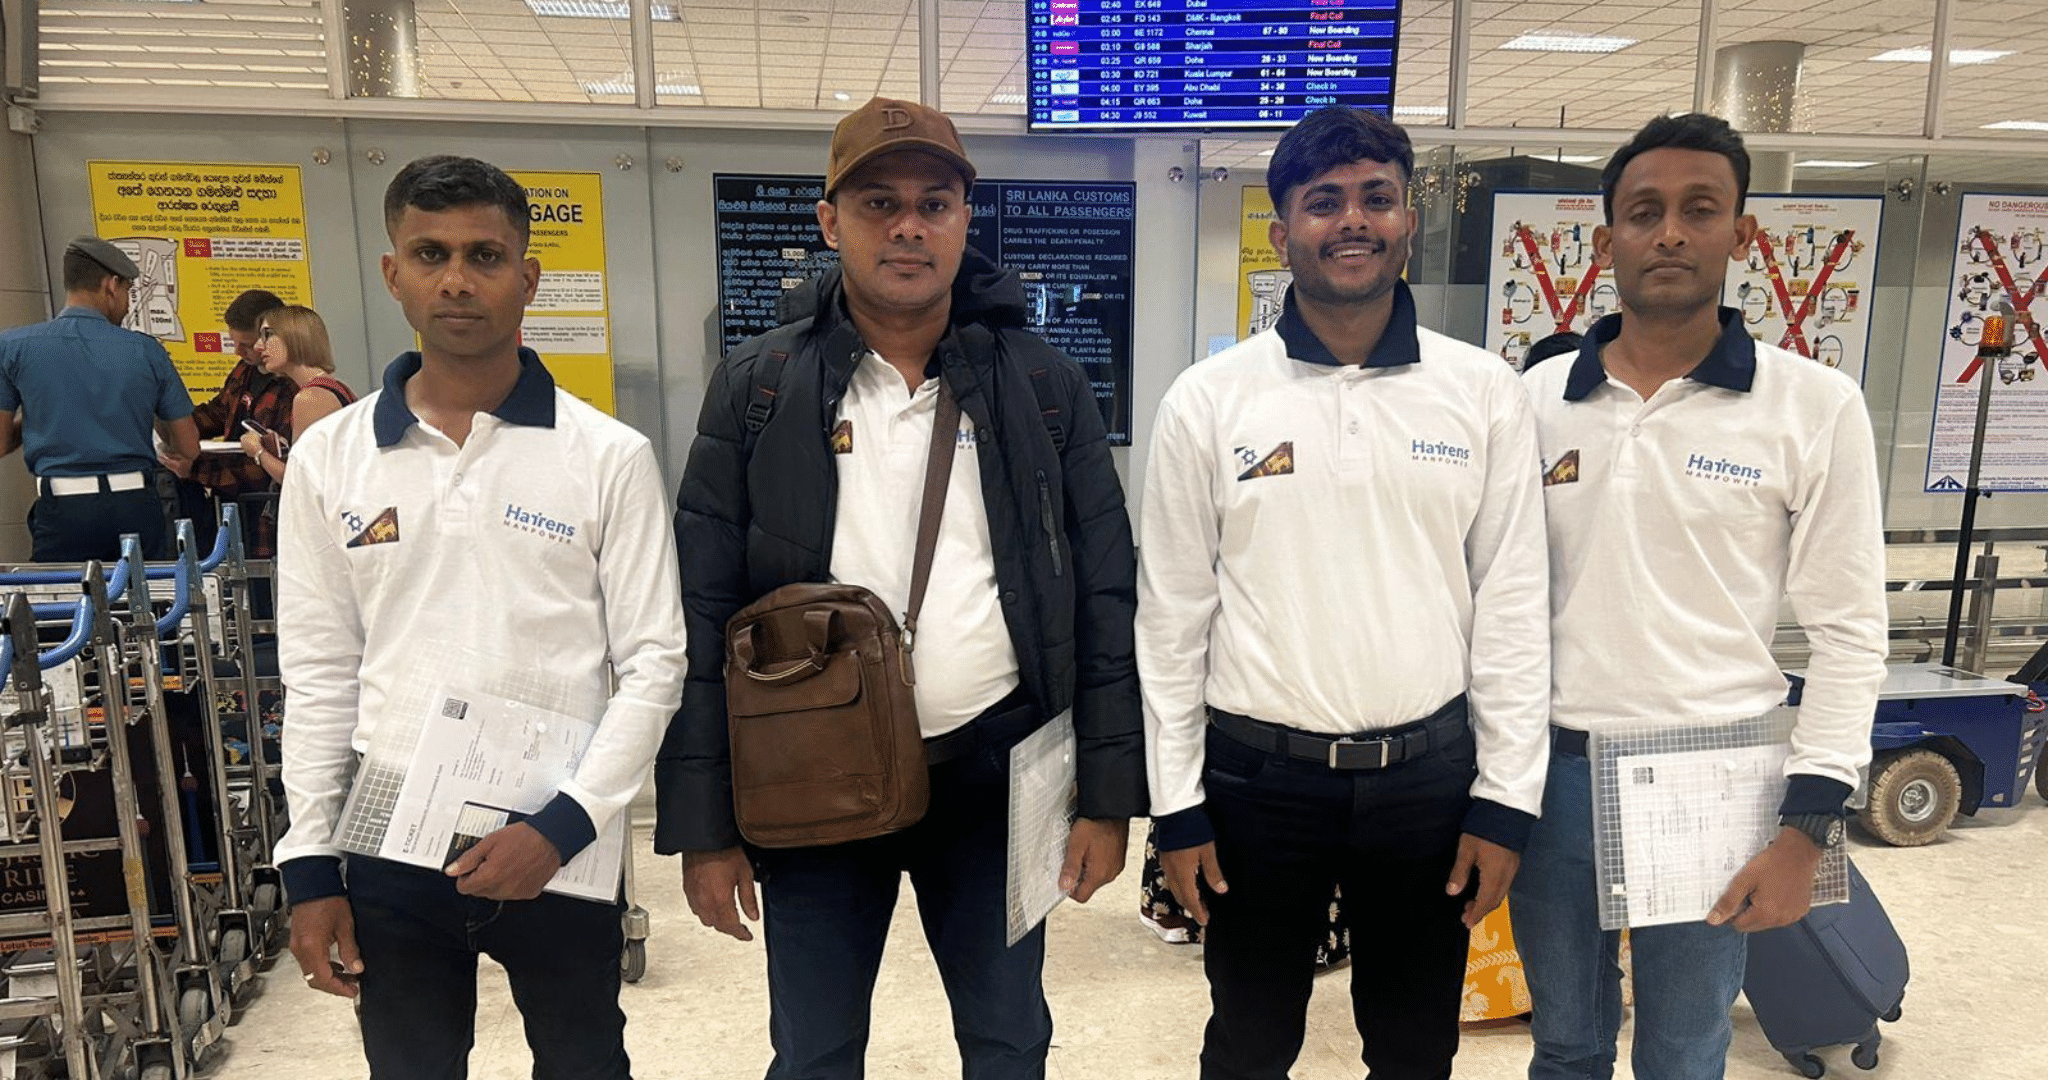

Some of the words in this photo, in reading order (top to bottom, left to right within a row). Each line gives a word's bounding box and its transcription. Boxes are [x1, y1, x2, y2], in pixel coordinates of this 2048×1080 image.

[1327, 25, 1360, 36] Boarding
[1325, 53, 1358, 63] Boarding
[1324, 68, 1357, 78] Boarding
[881, 108, 915, 134] D
[525, 188, 552, 198] ATION
[554, 188, 569, 198] ON
[1006, 190, 1025, 200] SRI
[1028, 190, 1068, 201] LANKA
[1073, 191, 1130, 202] CUSTOMS
[529, 204, 583, 223] GAGE
[1005, 205, 1021, 215] TO
[1027, 205, 1049, 216] ALL
[1054, 206, 1132, 218] PASSENGERS
[1685, 469, 1759, 487] MANPOWER
[503, 520, 572, 544] MANPOWER
[74, 934, 99, 943] ombo
